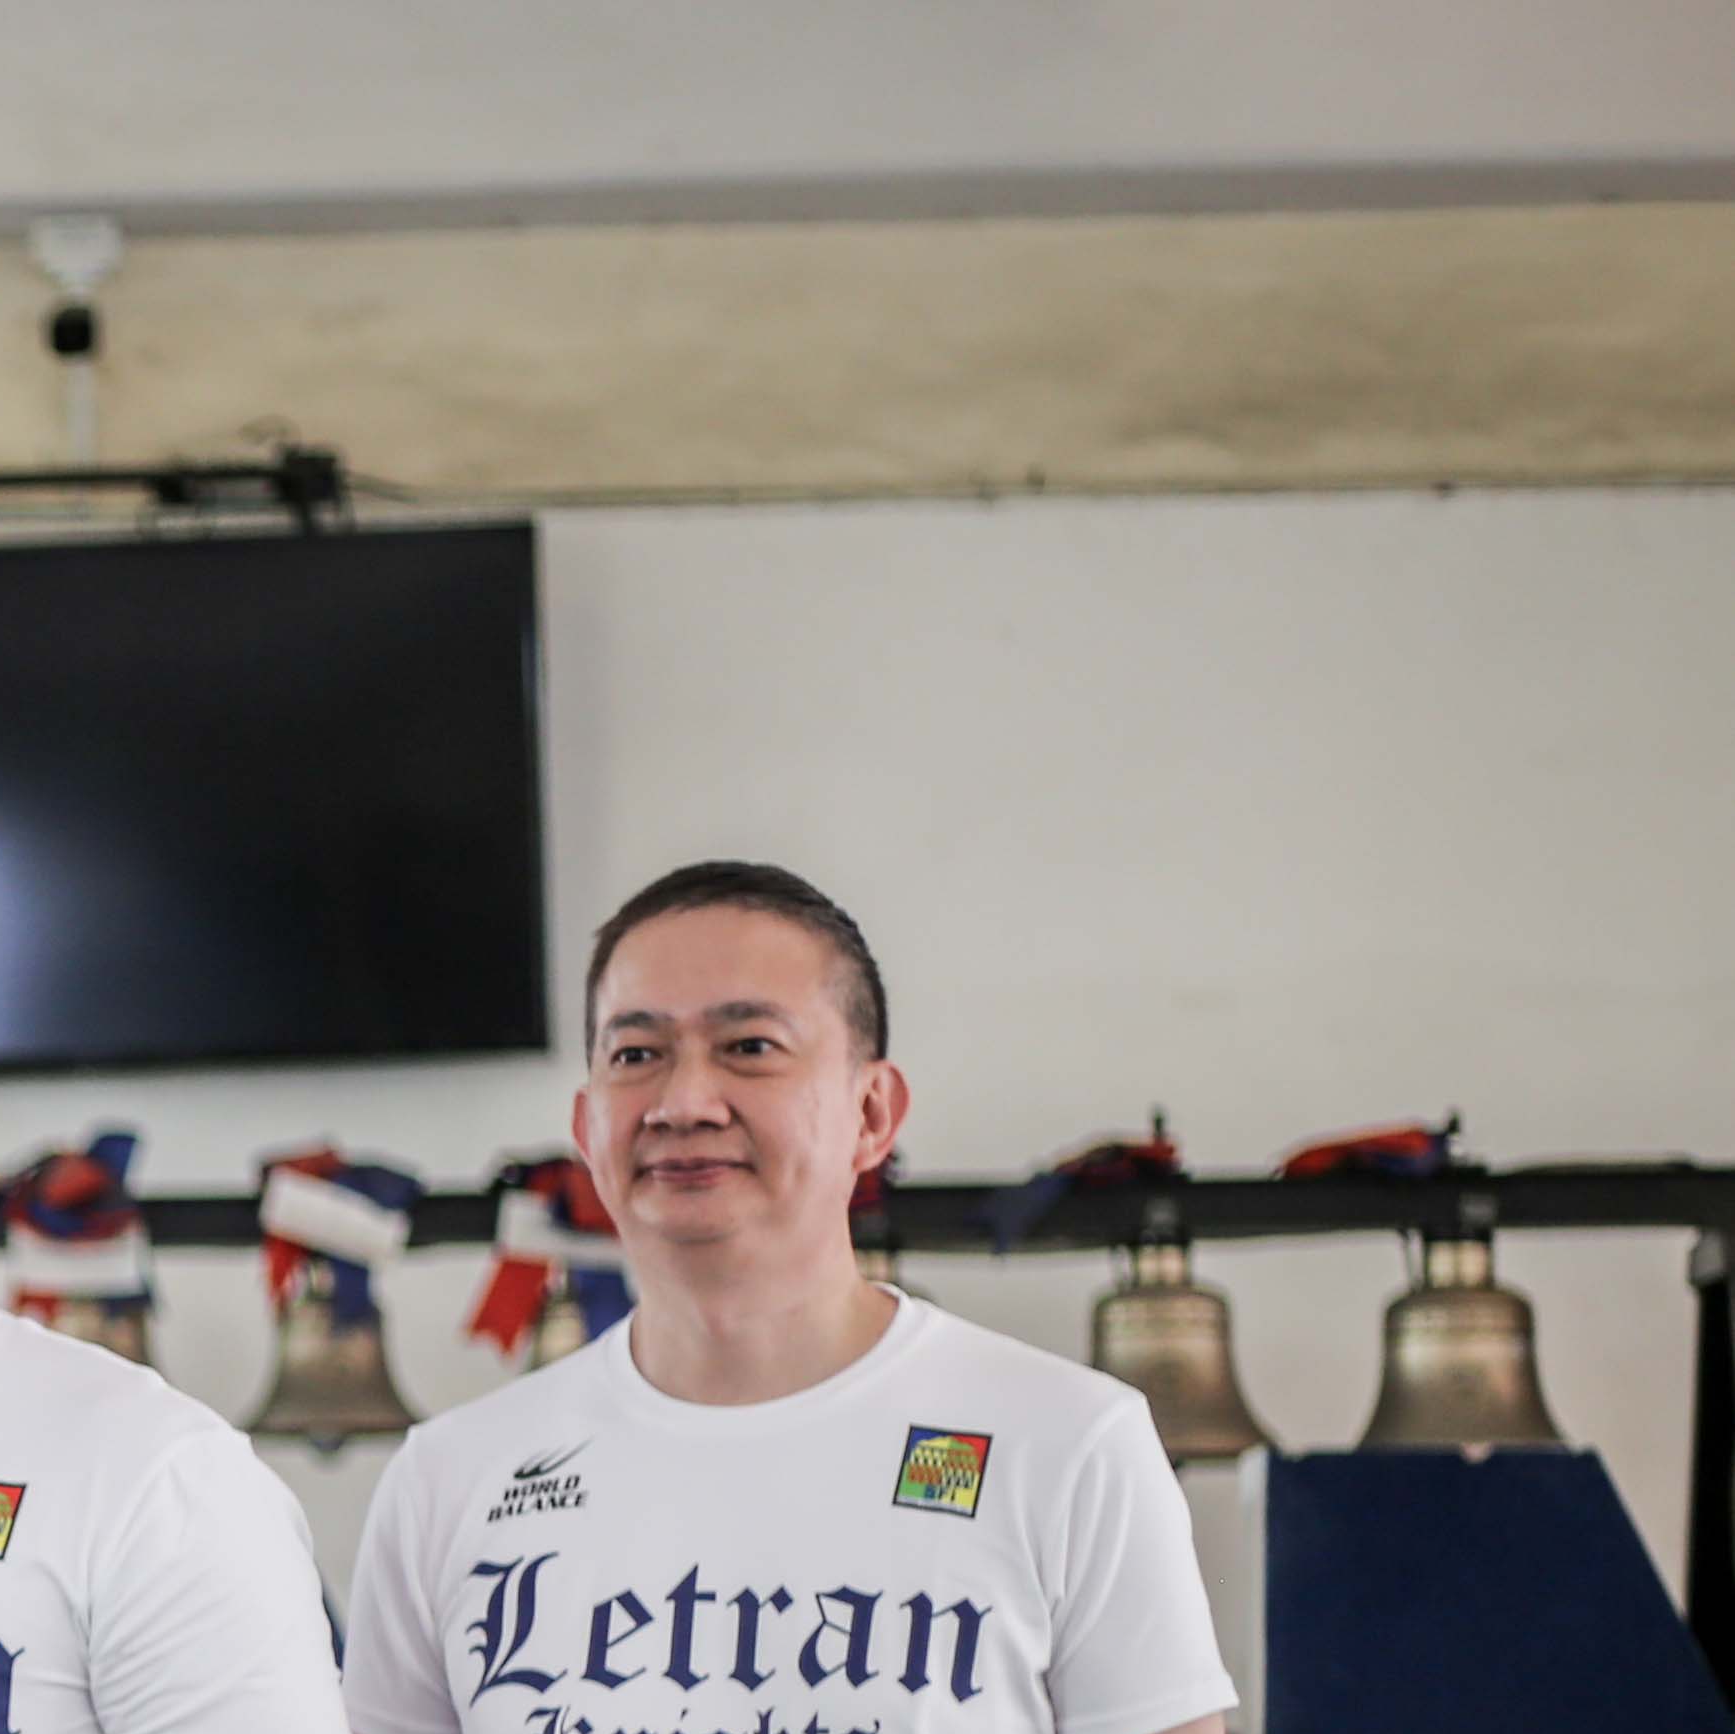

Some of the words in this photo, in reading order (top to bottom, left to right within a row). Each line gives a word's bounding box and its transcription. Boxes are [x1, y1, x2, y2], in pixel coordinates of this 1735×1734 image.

[503, 1474, 580, 1502] WORLD
[487, 1491, 589, 1523] BALANCE
[467, 1552, 992, 1706] Letran
